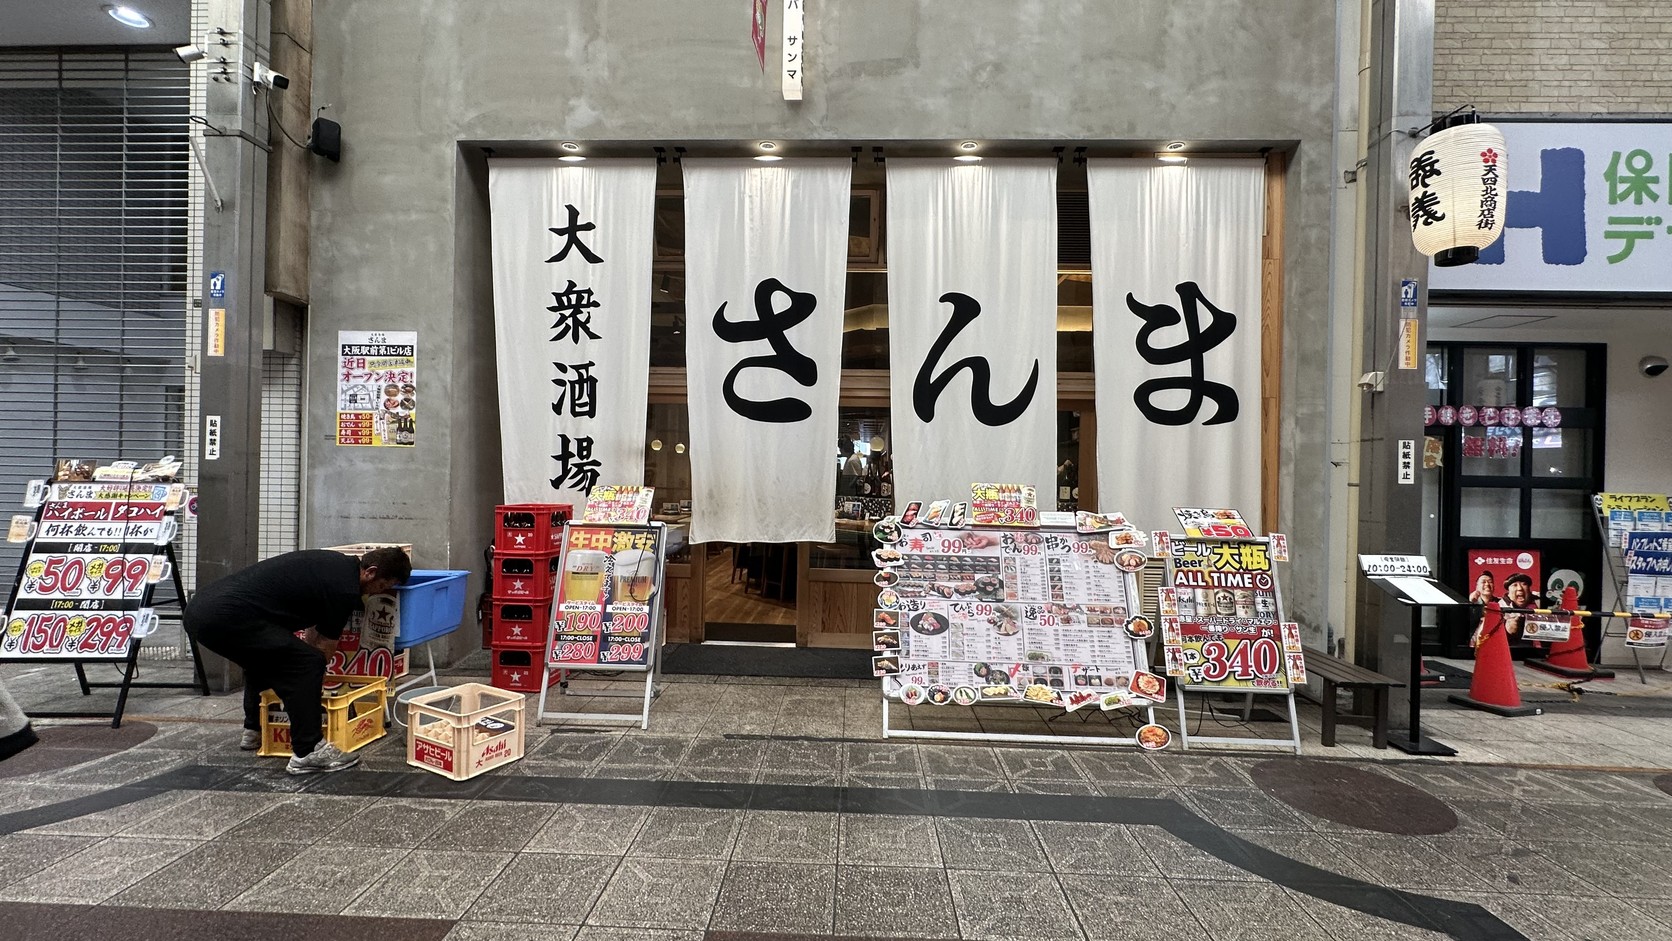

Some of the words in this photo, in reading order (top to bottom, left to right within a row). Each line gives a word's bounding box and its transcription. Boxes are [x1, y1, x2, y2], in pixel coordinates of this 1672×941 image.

[787, 36, 798, 79] サンマ
[1603, 148, 1672, 205] 保
[1475, 164, 1499, 230] 天四北商店街
[1604, 216, 1672, 265] デ
[343, 346, 412, 355] 大阪駅前第1ビル店
[544, 204, 605, 498] 大衆酒場
[342, 357, 366, 370] 近日
[341, 371, 413, 383] オープン決定!
[209, 420, 218, 456] 貼紙禁止
[1402, 441, 1411, 480] 貼紙禁止
[1609, 495, 1656, 503] ライフプラン
[46, 507, 108, 519] ハイボール
[114, 504, 165, 518] タコハイ
[1201, 525, 1252, 537] ¥50
[570, 530, 655, 553] 生中激安
[1001, 533, 1023, 554] おでん
[1045, 534, 1071, 553] 串かつ
[1172, 541, 1211, 556] ビール
[1212, 542, 1269, 571] 大瓶
[1174, 558, 1203, 568] Beer
[1175, 572, 1206, 586] ALL
[1211, 573, 1253, 587] TIME
[1261, 628, 1274, 637] が!
[1540, 623, 1568, 632] 侵入禁止
[1183, 652, 1197, 661] 1本
[1071, 663, 1100, 676] デザート
[416, 741, 452, 761] アサヒビール
[482, 739, 507, 757] Asahi
[476, 759, 483, 768] 大
